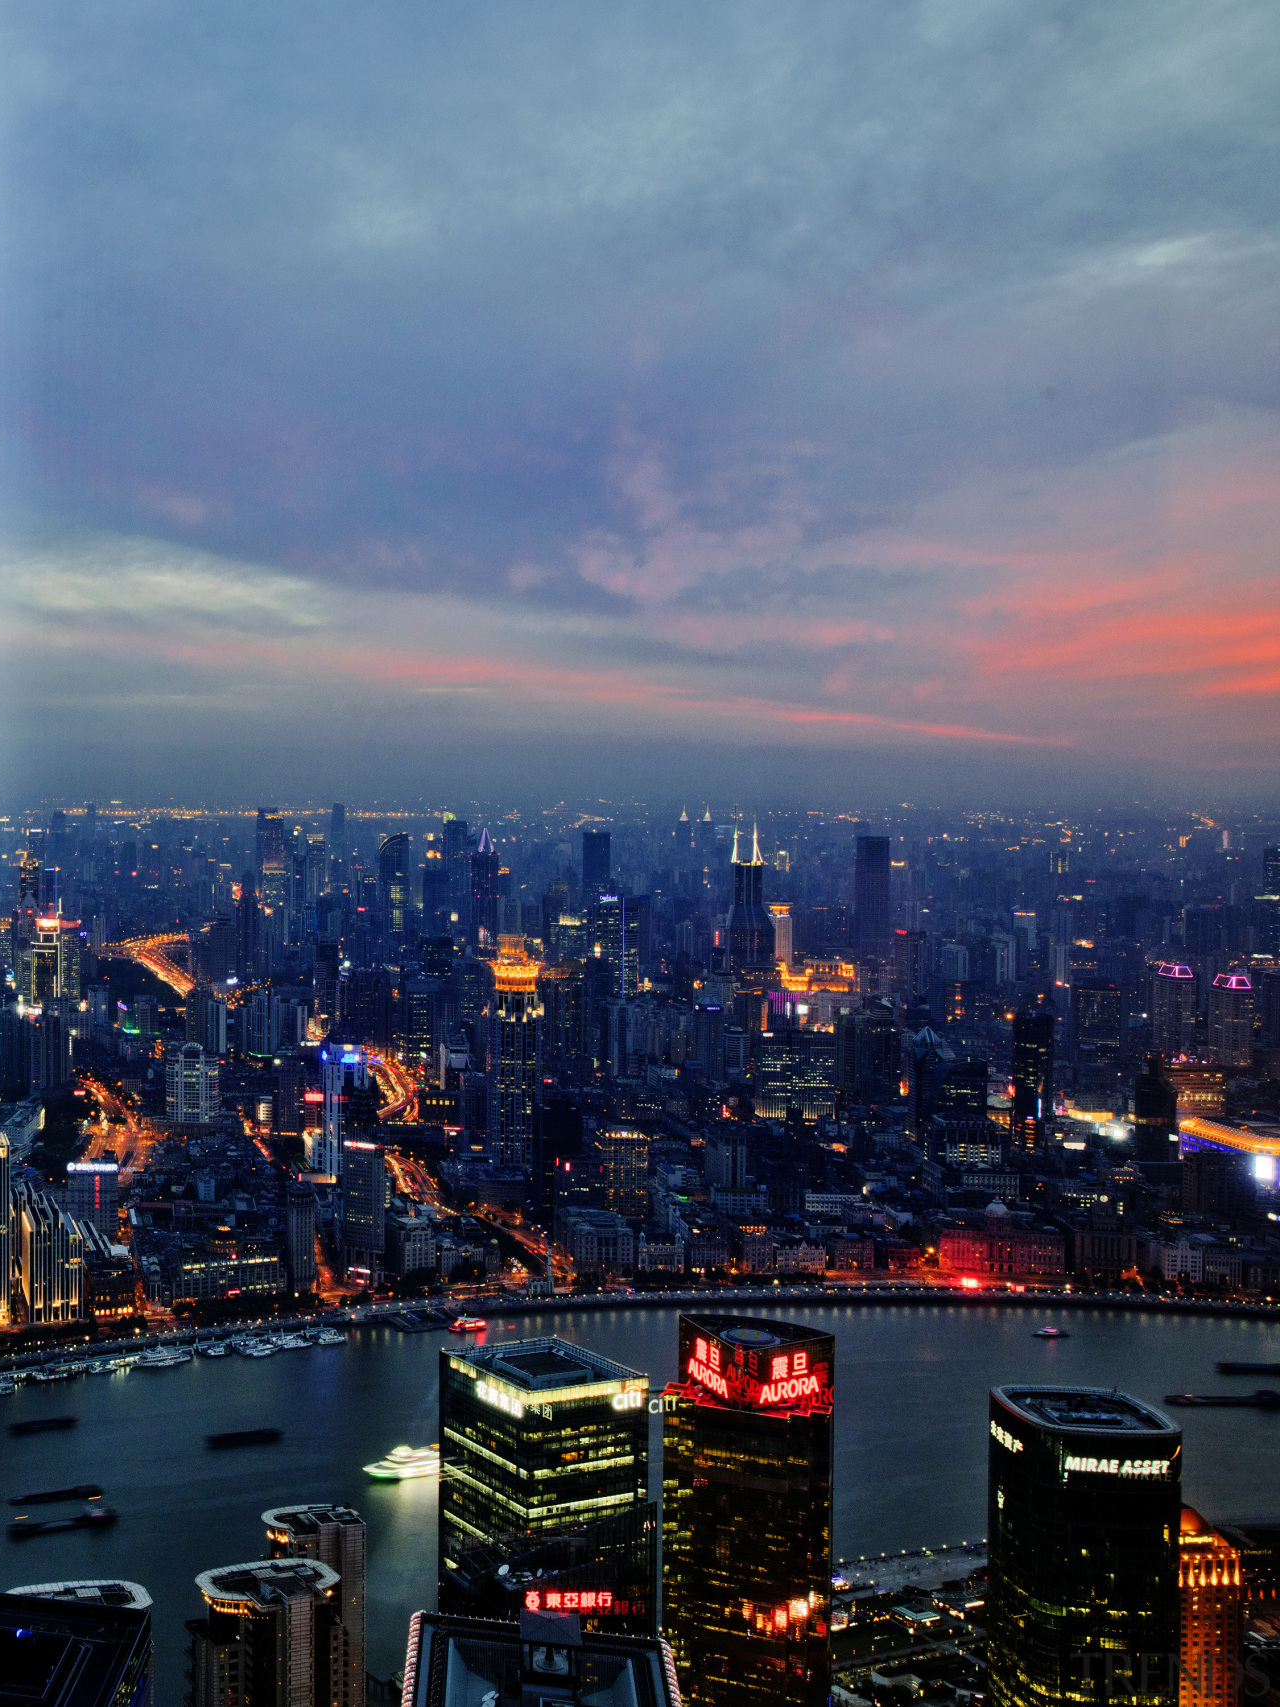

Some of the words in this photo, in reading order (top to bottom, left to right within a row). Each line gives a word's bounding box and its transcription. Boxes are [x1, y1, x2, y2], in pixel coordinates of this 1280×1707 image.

[696, 1337, 721, 1372] 震旦
[772, 1352, 808, 1381] 震旦
[687, 1358, 729, 1399] AURORA
[759, 1376, 820, 1404] AURORA
[476, 1380, 523, 1418] 花旗集团
[612, 1384, 642, 1410] citi
[1065, 1456, 1119, 1473] MIRAE
[1121, 1460, 1170, 1474] ASSET
[546, 1591, 612, 1608] 東亞銀行
